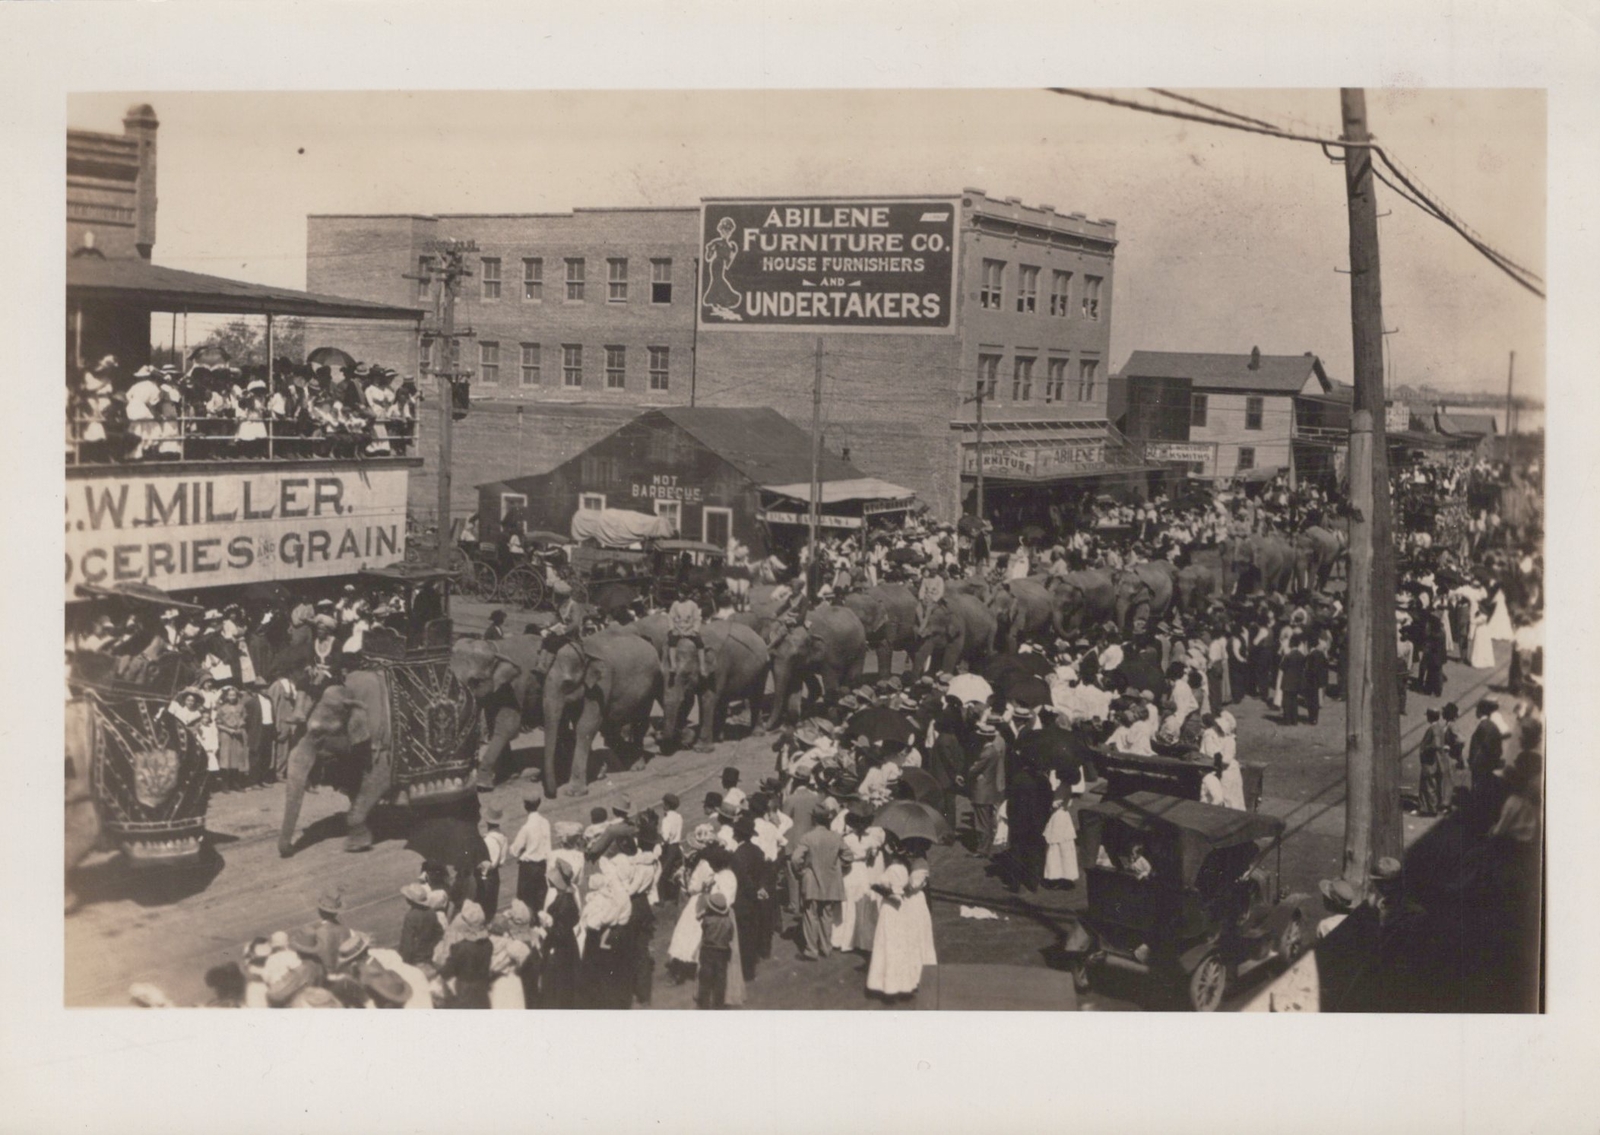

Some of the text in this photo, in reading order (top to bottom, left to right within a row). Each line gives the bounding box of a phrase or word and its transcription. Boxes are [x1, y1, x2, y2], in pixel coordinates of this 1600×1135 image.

[763, 206, 890, 228] ABILENE
[742, 228, 951, 252] FURNITURE CO.
[762, 256, 926, 272] HOUSE FURNISHERS
[820, 277, 846, 287] AND
[745, 291, 941, 318] UNDERTAKERS
[968, 456, 1032, 475] FRNITURE
[653, 474, 679, 488] HOT
[65, 536, 255, 583] CERIES
[279, 525, 402, 569] GRAIN.
